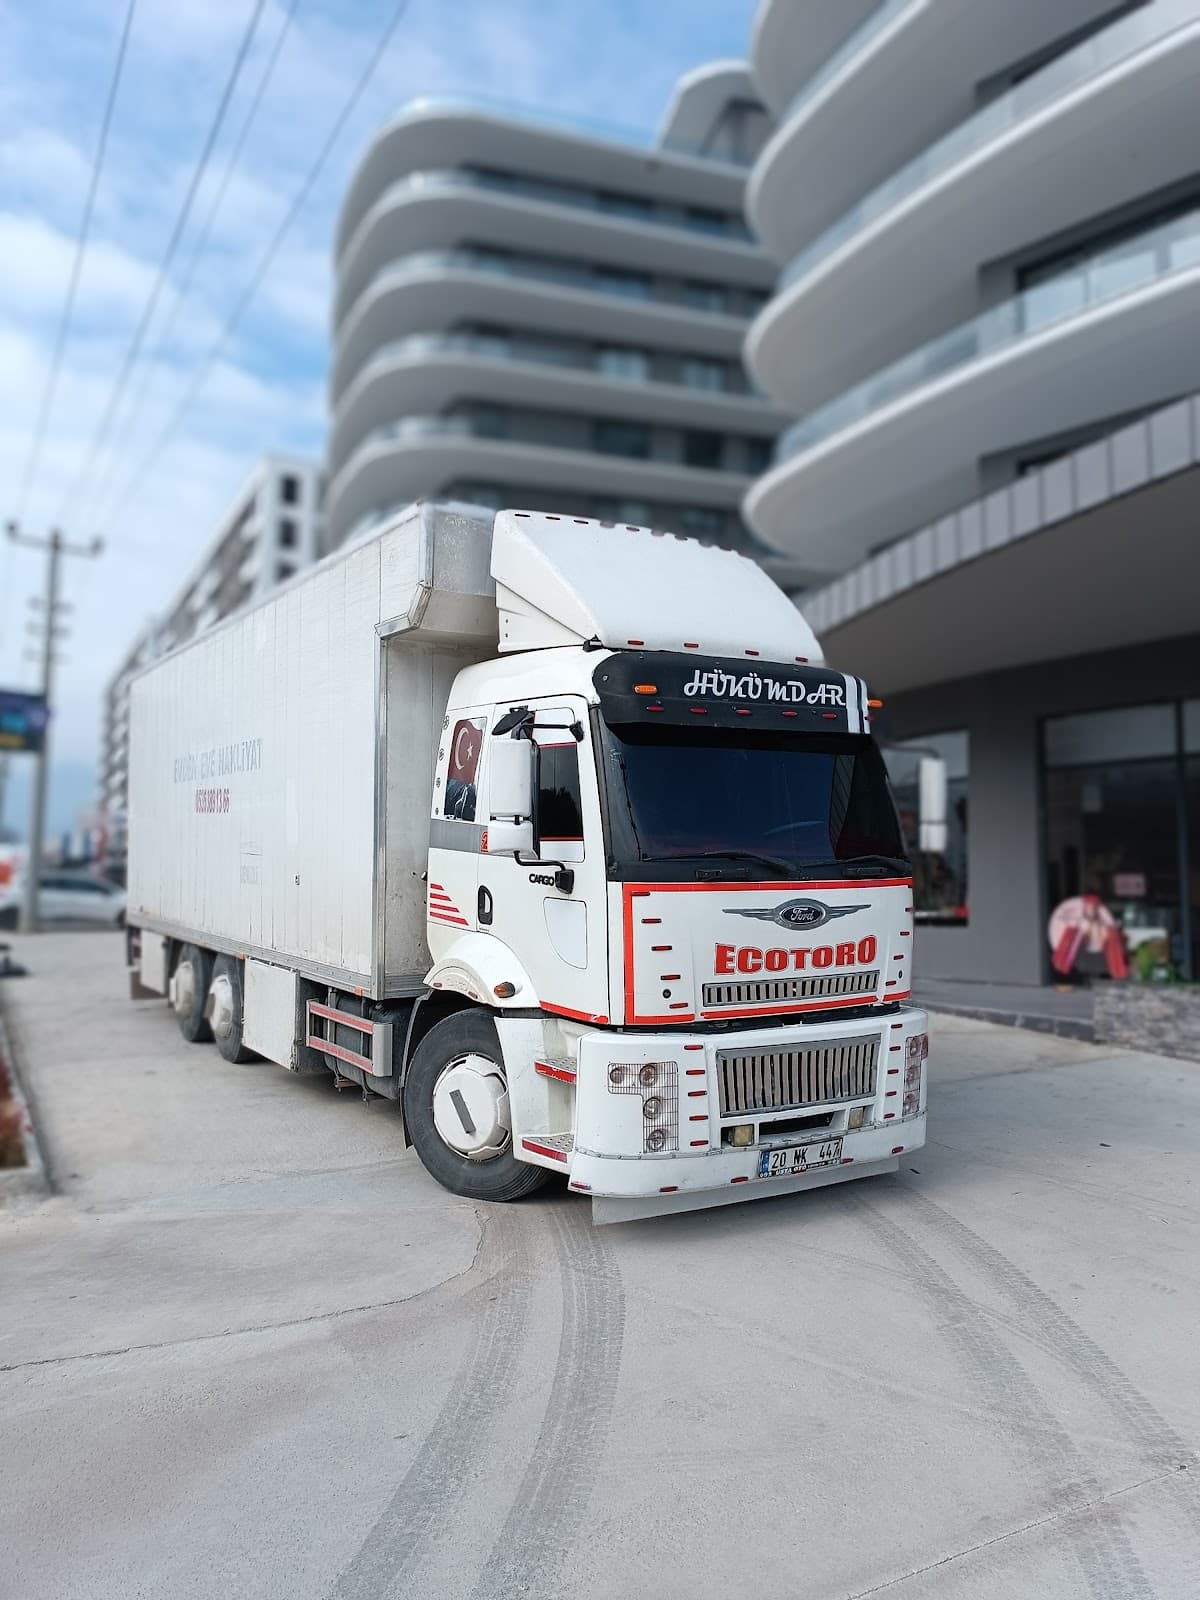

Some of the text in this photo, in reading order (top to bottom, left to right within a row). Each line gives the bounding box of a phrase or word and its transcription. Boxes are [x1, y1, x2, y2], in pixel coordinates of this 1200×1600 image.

[683, 669, 847, 706] HÜKÜMDAR
[528, 873, 555, 887] CARGO
[790, 906, 815, 921] Ford
[714, 935, 877, 976] ECOTORO
[772, 1152, 787, 1169] 20
[793, 1147, 808, 1166] NK
